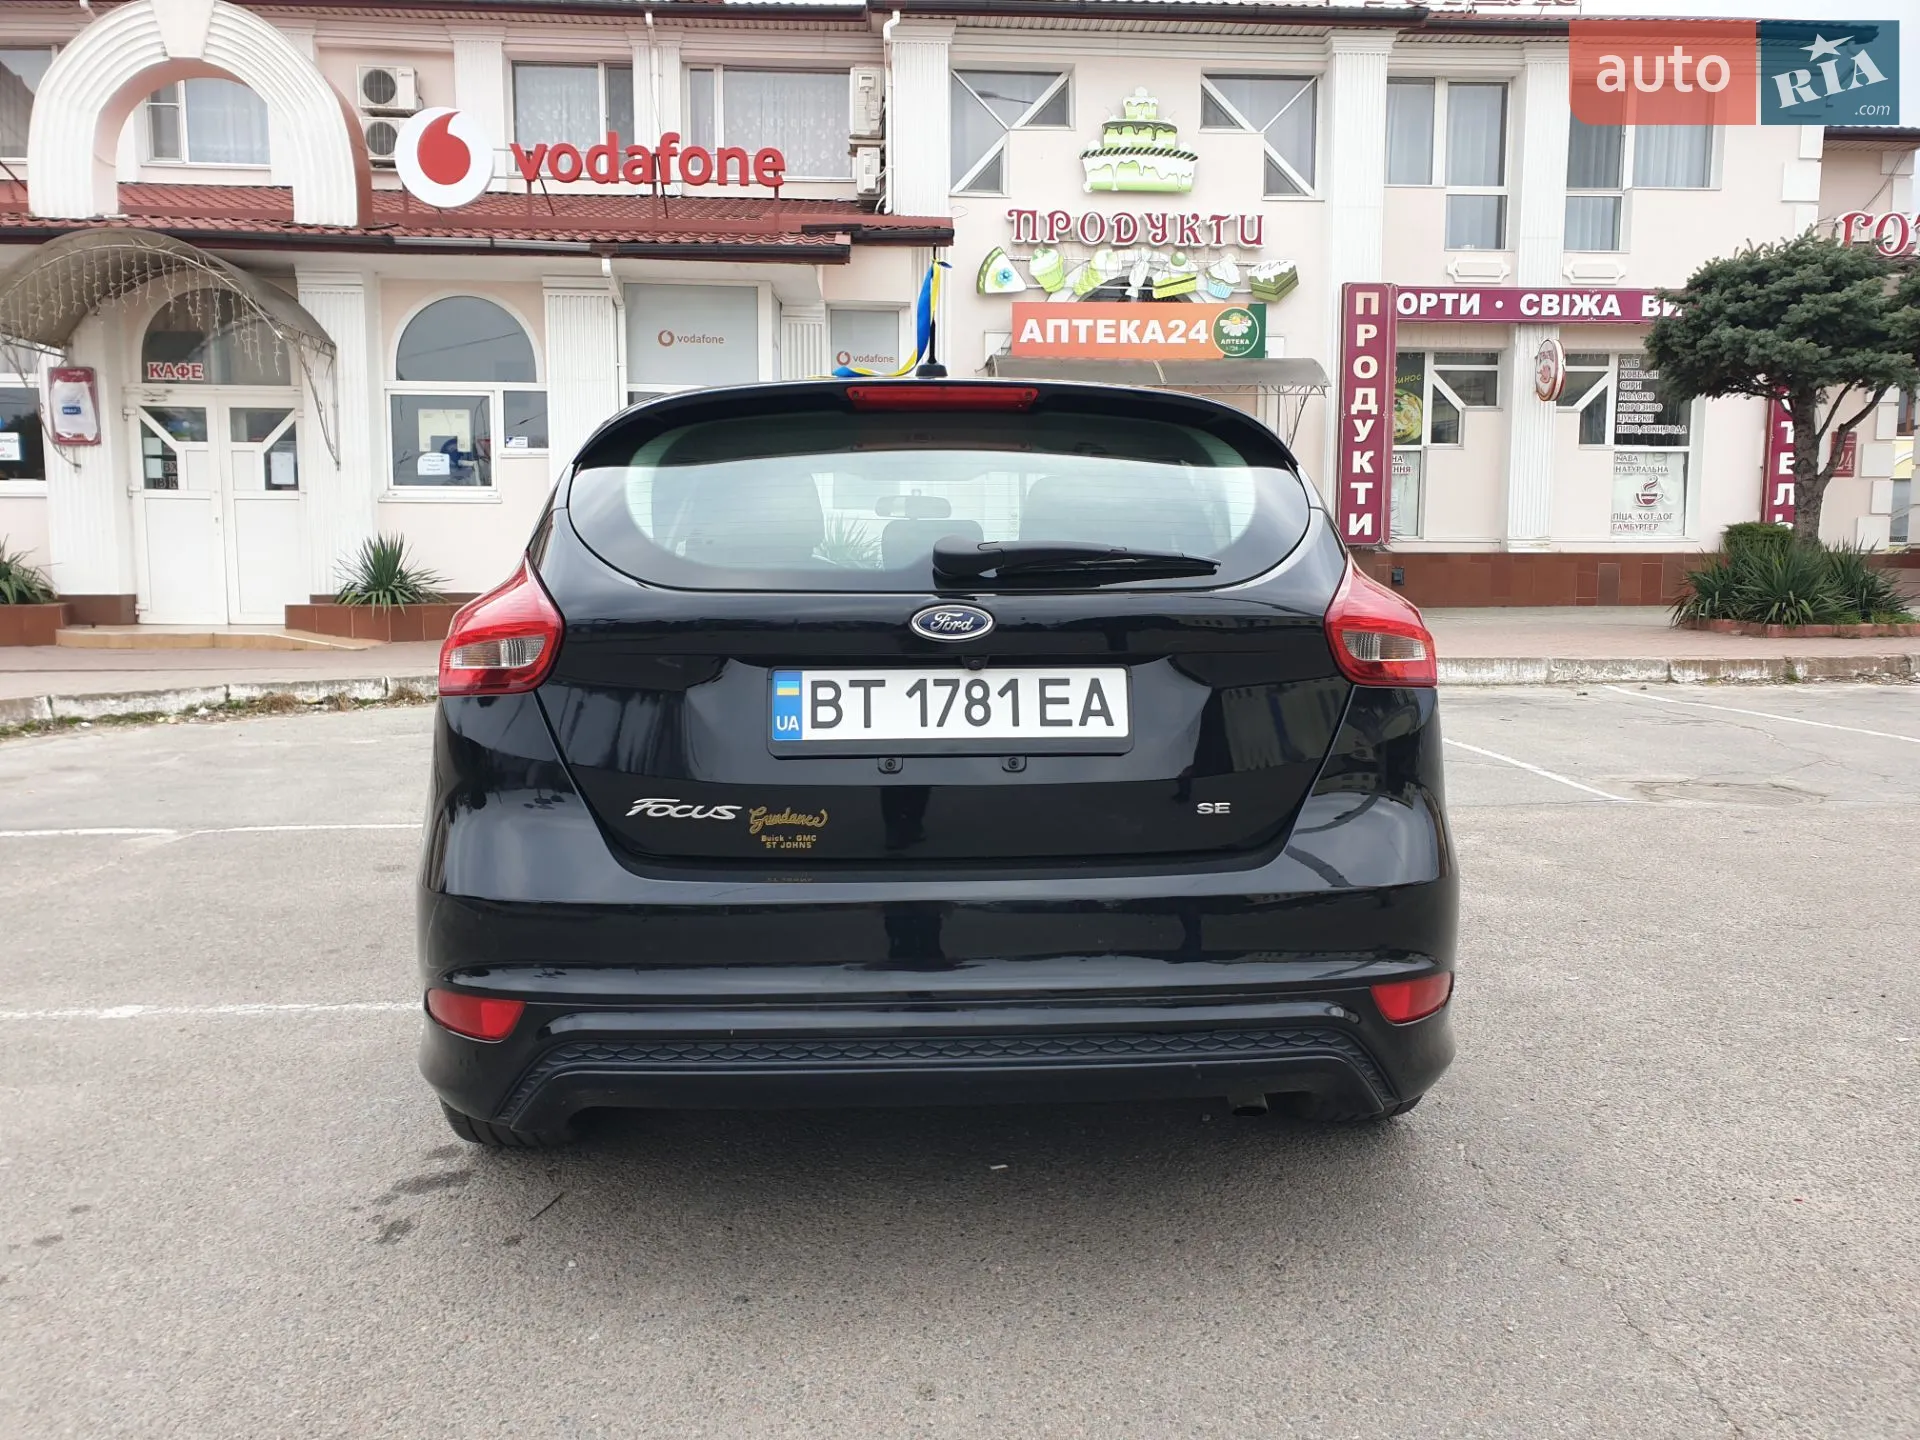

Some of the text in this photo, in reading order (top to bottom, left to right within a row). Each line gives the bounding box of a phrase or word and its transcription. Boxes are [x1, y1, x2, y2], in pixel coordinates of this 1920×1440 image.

[509, 131, 786, 187] vodafone
[1007, 208, 1265, 248] ПРОДУКТИ
[1836, 210, 1920, 257] ГО
[1396, 293, 1684, 317] ОРТИ СВІЖА ВИ
[677, 333, 725, 345] vodafone
[1019, 319, 1209, 344] АПТЕКА24
[853, 354, 895, 364] vodafone
[147, 362, 204, 380] КАФЕ
[1619, 392, 1655, 401] МОЛОКО
[1348, 291, 1380, 536] ПРОДУКТИ
[1617, 403, 1663, 412] МОРОЗИВО
[1612, 523, 1659, 531] ГАМБУРГЕР
[930, 612, 974, 632] Ford
[810, 678, 1115, 729] BT 1781 EA
[776, 715, 800, 731] UA
[1197, 802, 1231, 814] SE
[761, 834, 817, 842] Buick GMC
